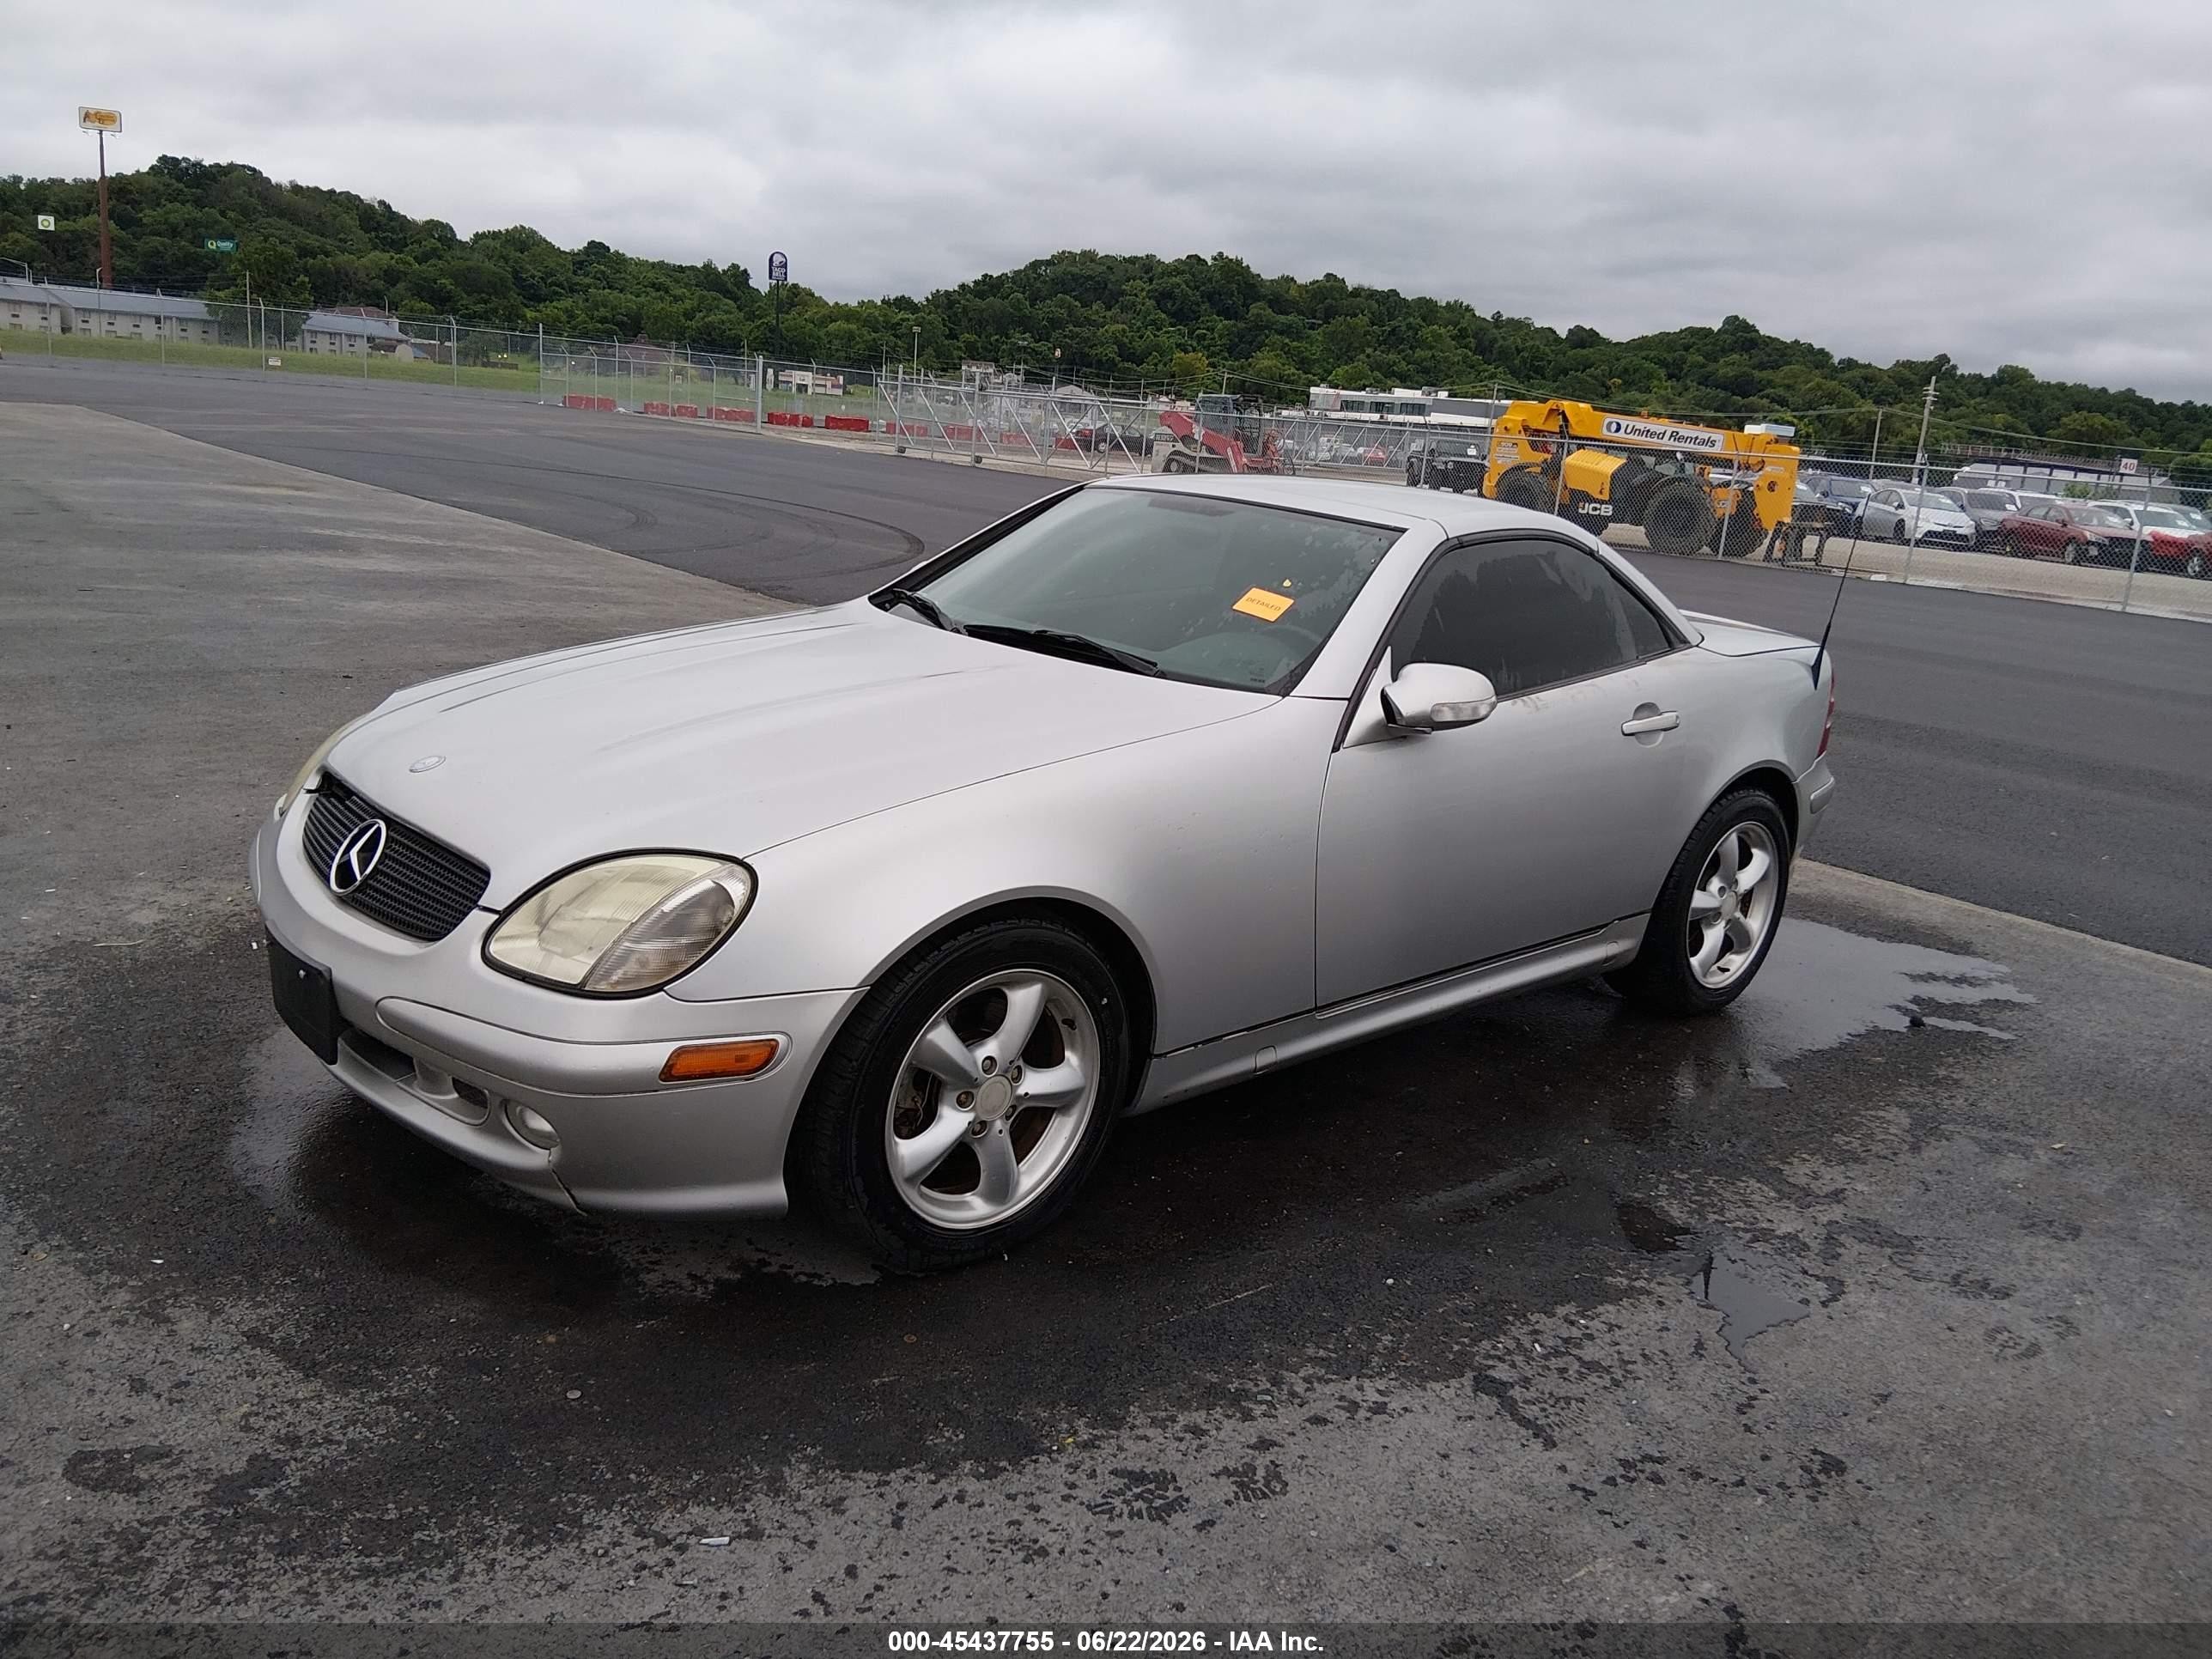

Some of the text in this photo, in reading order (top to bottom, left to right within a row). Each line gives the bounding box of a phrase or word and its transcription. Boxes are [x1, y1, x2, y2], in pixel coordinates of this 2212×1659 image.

[1624, 423, 1717, 448] United Rentals
[2122, 462, 2136, 471] 40
[1578, 501, 1613, 516] JCB
[1245, 596, 1282, 612] DETAILED
